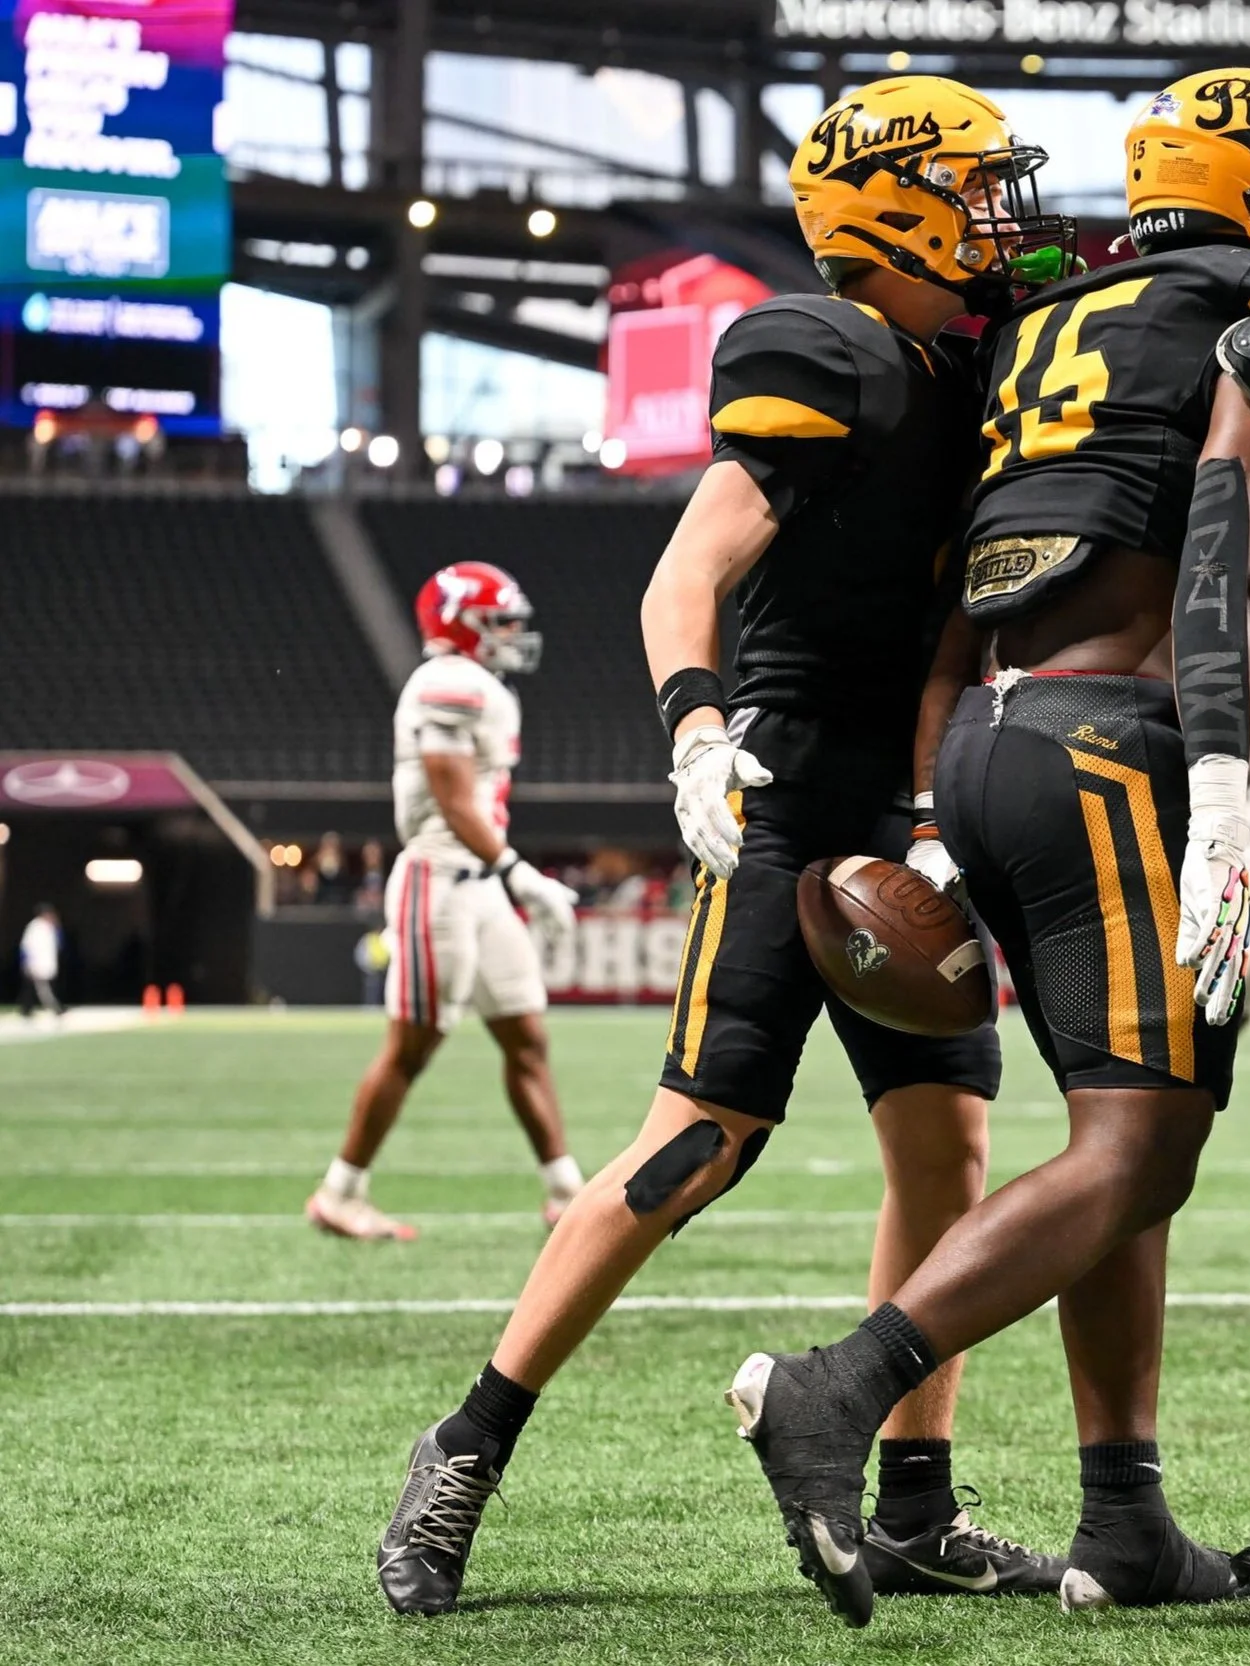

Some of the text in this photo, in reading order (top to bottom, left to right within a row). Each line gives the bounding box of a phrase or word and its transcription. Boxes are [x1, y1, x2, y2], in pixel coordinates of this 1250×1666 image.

[808, 103, 941, 175] Rams
[1133, 139, 1146, 161] 15
[981, 277, 1154, 481] 15
[1067, 724, 1119, 750] Rams
